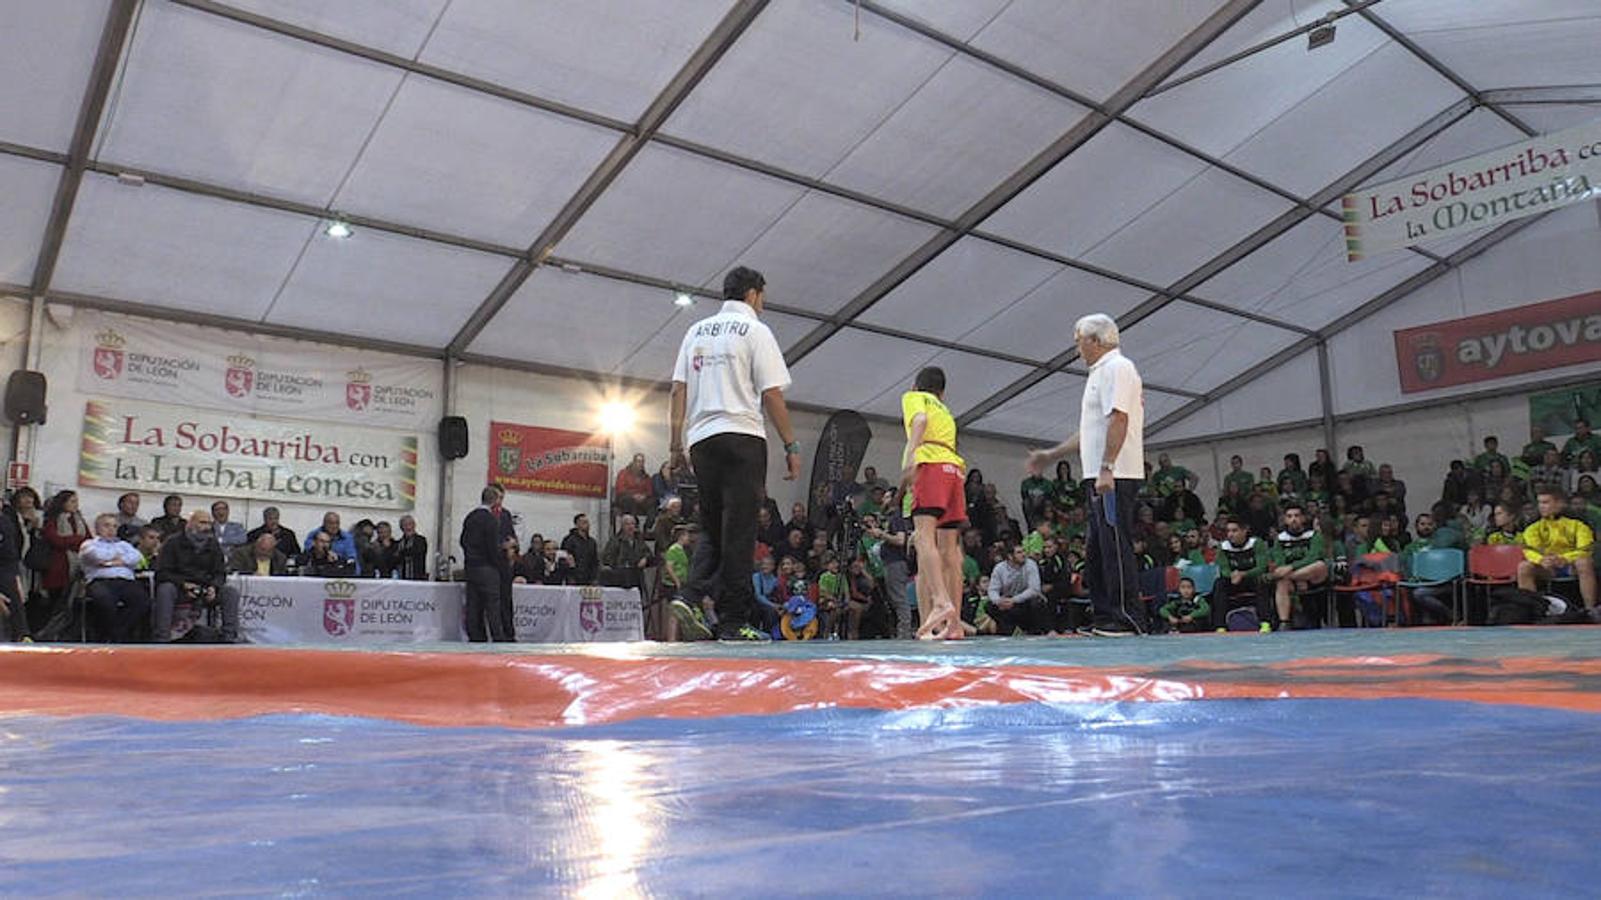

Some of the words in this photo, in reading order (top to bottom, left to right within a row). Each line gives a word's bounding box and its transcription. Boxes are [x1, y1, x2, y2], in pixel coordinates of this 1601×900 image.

[1370, 195, 1405, 220] La
[1411, 148, 1569, 207] Sobarriba
[1406, 221, 1427, 239] la
[1432, 174, 1591, 231] Montaña
[1458, 314, 1601, 367] aytova
[128, 352, 200, 371] DIPUTACIÓN
[128, 363, 142, 374] DE
[256, 381, 270, 392] DE
[117, 415, 165, 447] La
[175, 421, 343, 464] Sobarriba
[349, 452, 389, 469] con
[545, 450, 608, 464] Sobarriba
[115, 457, 138, 481] la
[146, 454, 256, 490] Lucha
[263, 465, 395, 501] Leonesa
[361, 599, 436, 612] DIPUTACIÓN
[361, 612, 377, 624] DE
